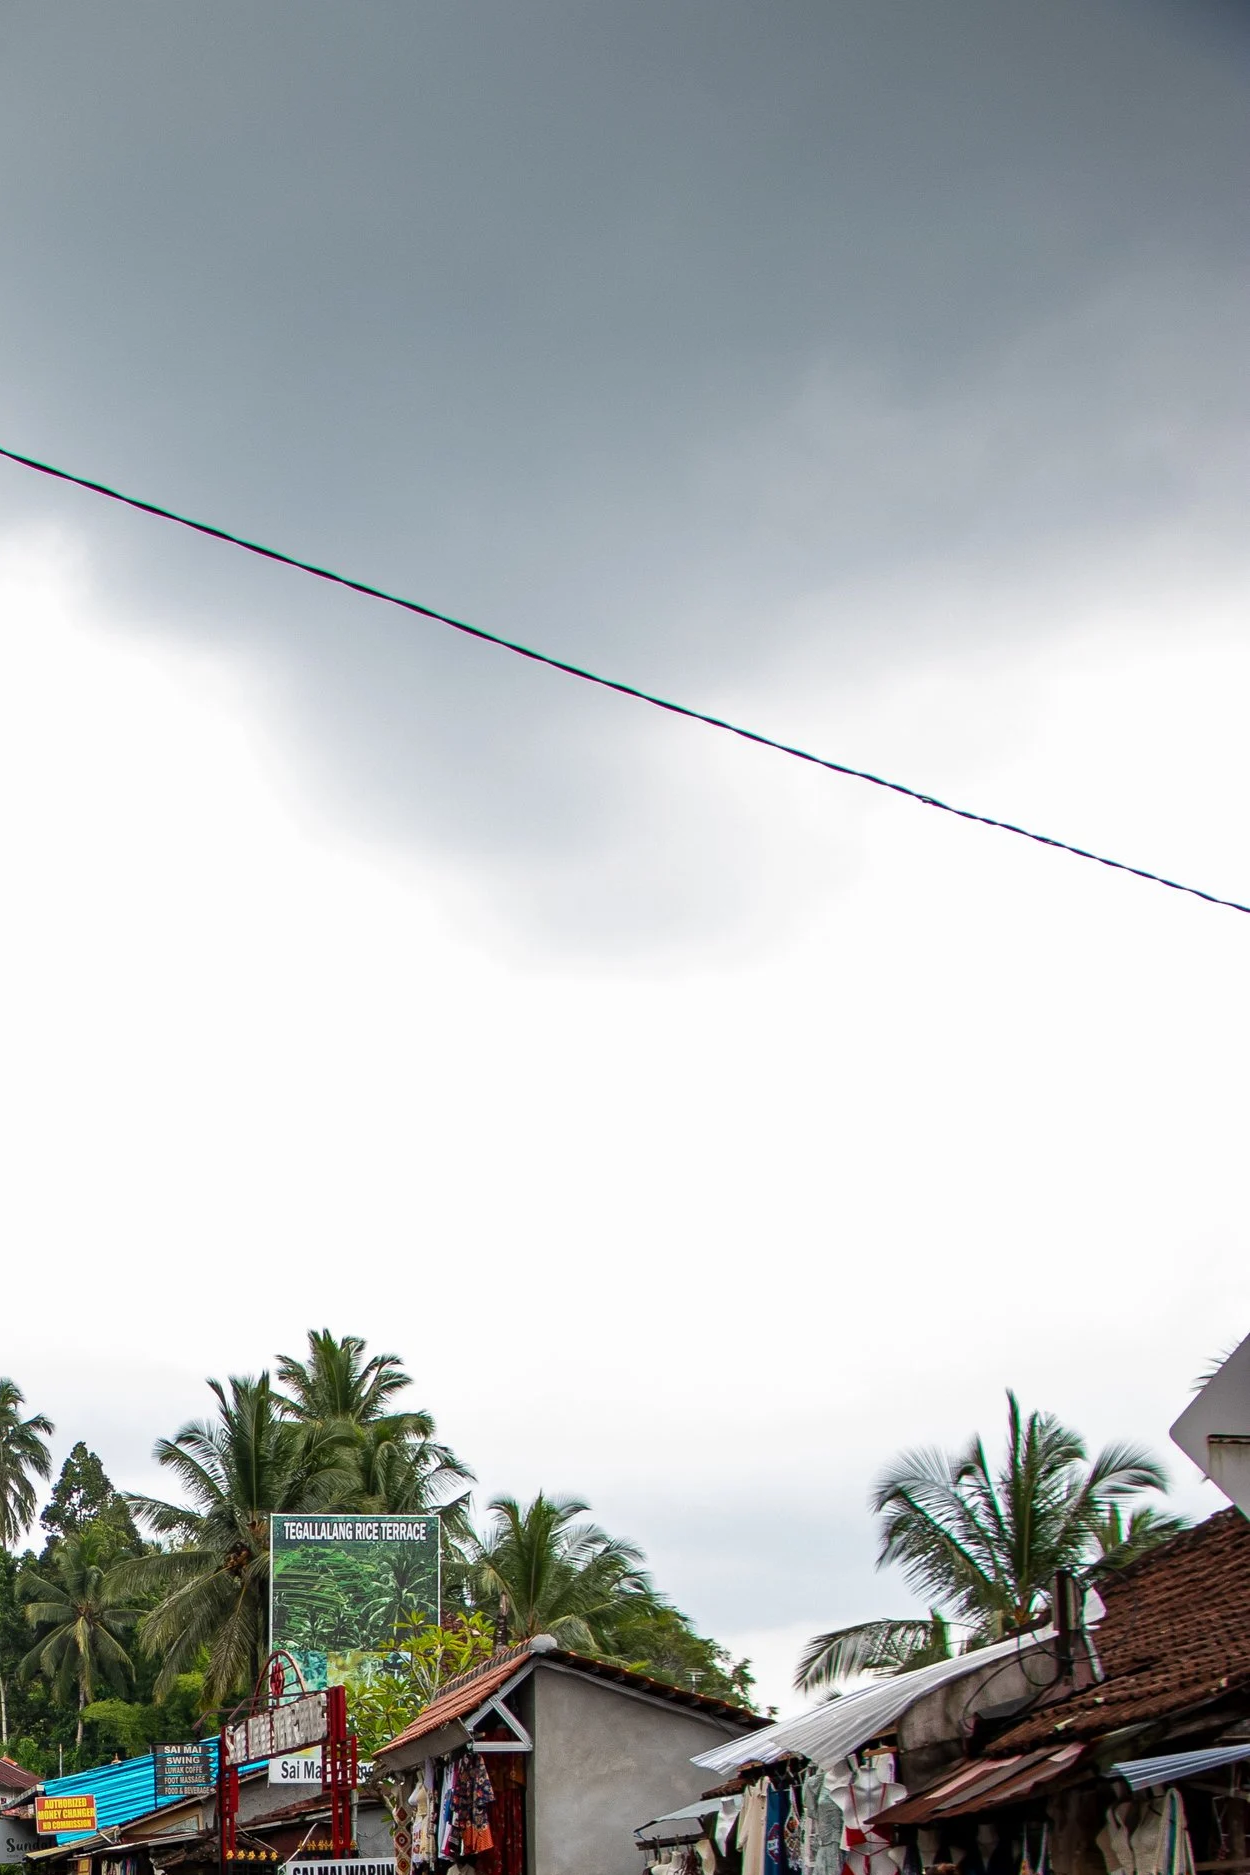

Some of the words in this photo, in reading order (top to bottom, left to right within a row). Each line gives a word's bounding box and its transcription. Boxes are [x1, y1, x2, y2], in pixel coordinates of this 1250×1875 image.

[284, 1522, 353, 1540] TEGALLALANG
[355, 1522, 379, 1540] RICE
[381, 1522, 426, 1540] TERRACE
[164, 1746, 181, 1754] SAI
[183, 1746, 202, 1754] MAI
[166, 1756, 200, 1764] SWING
[281, 1760, 300, 1779] Sai
[303, 1760, 323, 1779] Ma
[180, 1775, 205, 1783] MASSAGE
[164, 1786, 179, 1794] FOOD
[184, 1786, 210, 1794] BEVERAGE
[45, 1797, 87, 1809] AUTHORIZED
[38, 1809, 61, 1820] MONEY
[62, 1808, 95, 1818] CHANGER
[42, 1821, 52, 1830] NO
[52, 1819, 91, 1830] COMMISSION
